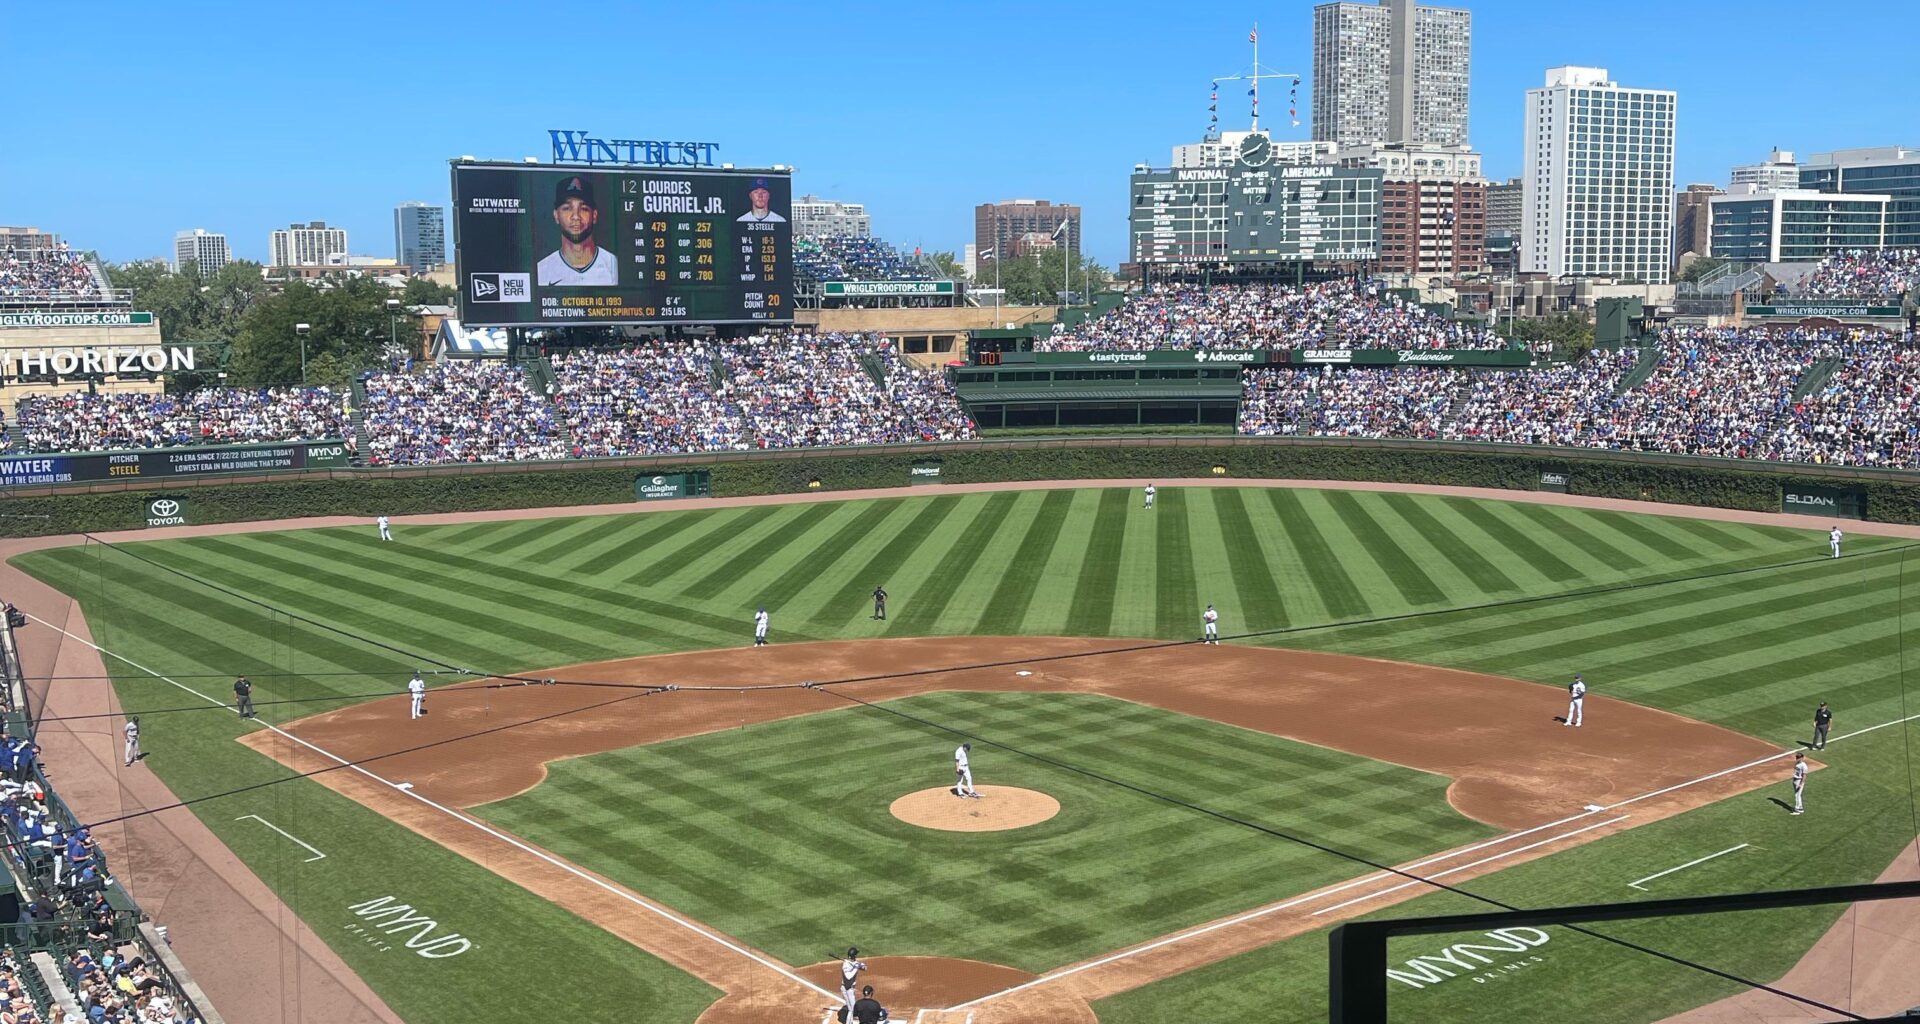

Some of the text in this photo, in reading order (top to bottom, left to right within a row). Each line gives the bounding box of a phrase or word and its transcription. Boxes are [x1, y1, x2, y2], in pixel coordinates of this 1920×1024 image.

[548, 130, 719, 166] WINTRUST
[1178, 169, 1229, 180] NATIONAL
[1281, 167, 1333, 178] AMERICAN
[622, 180, 692, 194] 12 LOURDES
[473, 198, 520, 208] CUTWATER
[624, 201, 635, 212] LF
[643, 195, 726, 214] GURRIEL JR.
[634, 222, 667, 232] AB 479
[678, 222, 711, 232] AVG .257
[755, 223, 775, 231] STEELE
[635, 238, 665, 248] HR 23
[678, 238, 712, 248] OBP .306
[655, 254, 665, 264] 73
[679, 255, 713, 264] SLG .474
[638, 271, 666, 280] R 59
[696, 271, 713, 280] .780
[503, 279, 524, 288] NEW
[843, 283, 937, 293] WRIGLEYROOFTOPS.COM
[504, 288, 524, 296] ERA
[745, 292, 763, 300] PITCH
[541, 297, 559, 306] DOB:
[562, 297, 594, 306] OCTOBER
[605, 297, 622, 306] 1993
[767, 294, 780, 306] 20
[542, 307, 656, 317] HOMETOWN: SANCTI SPIRITUS, CU
[661, 307, 686, 316] 215 LBS
[1775, 307, 1868, 315] WRIGLEYROOFTOPS.COM
[1096, 352, 1147, 363] tastytrade
[1208, 351, 1254, 361] Advocate
[1303, 350, 1353, 358] GRAINGER
[1398, 350, 1454, 361] Budweiser
[22, 346, 195, 375] HORIZON
[169, 454, 183, 463] 2.24
[184, 454, 197, 462] ERA
[197, 453, 215, 461] SINCE
[241, 449, 272, 459] (ENTERING
[273, 448, 295, 457] TODAY)
[308, 447, 343, 457] MYND
[109, 455, 139, 463] PITCHER
[109, 465, 140, 476] STEELE
[175, 463, 200, 472] LOWEST
[201, 463, 213, 471] ERA
[221, 462, 234, 470] MLB
[236, 460, 258, 469] DURING
[275, 459, 291, 467] SPAN
[5, 477, 13, 485] OF
[15, 476, 26, 484] THE
[28, 474, 54, 483] CHICAGO
[56, 473, 72, 482] CUBS
[640, 484, 678, 493] Gallagher
[1786, 494, 1834, 506] SLOAN
[147, 516, 185, 526] TOYOTA
[348, 896, 471, 958] MYND
[1386, 927, 1550, 989] MYND
